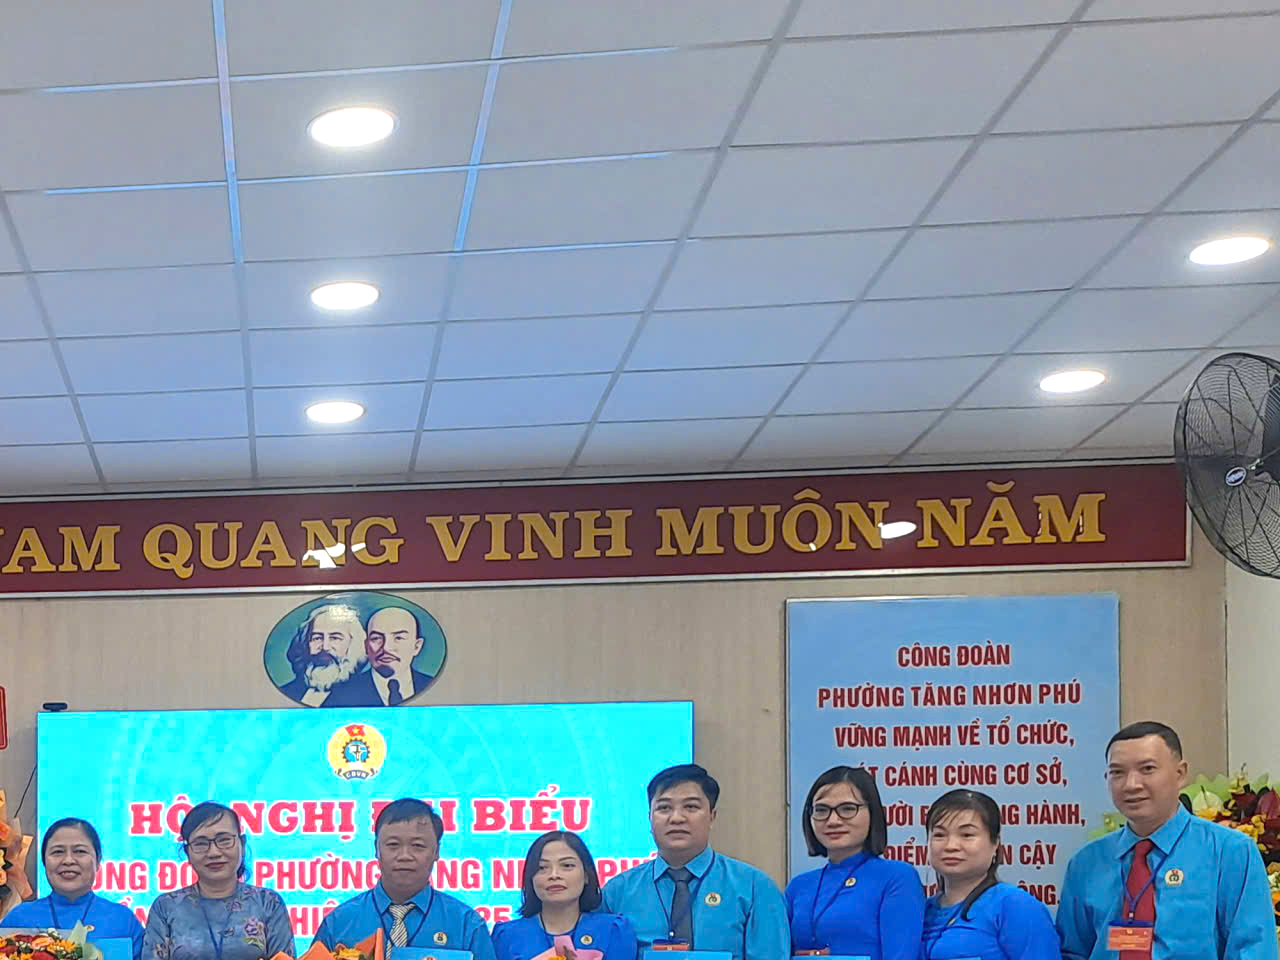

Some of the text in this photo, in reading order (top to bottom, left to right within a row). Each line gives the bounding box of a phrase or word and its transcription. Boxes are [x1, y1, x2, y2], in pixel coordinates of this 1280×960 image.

[142, 516, 405, 579] QUANG
[426, 508, 632, 562] VINH
[655, 487, 889, 556] MUÔN
[916, 480, 1107, 548] NĂM
[898, 641, 1010, 667] CÔNG ĐOÀN
[818, 679, 1081, 708] PHƯỜNG TĂNG NHƠN PHÚ
[835, 716, 1074, 751] VỮNG MẠNH VỀ TỔ CHỨC,
[885, 761, 937, 786] CÁNH
[944, 760, 997, 785] CÙNG
[1004, 764, 1030, 785] CƠ
[1036, 757, 1068, 787] SỞ,
[233, 801, 356, 840] NGHỊ
[474, 785, 591, 831] BIỂU
[883, 801, 913, 826] ƯỜI
[1027, 800, 1086, 827] HÀNH,
[1020, 840, 1056, 870] CẬY
